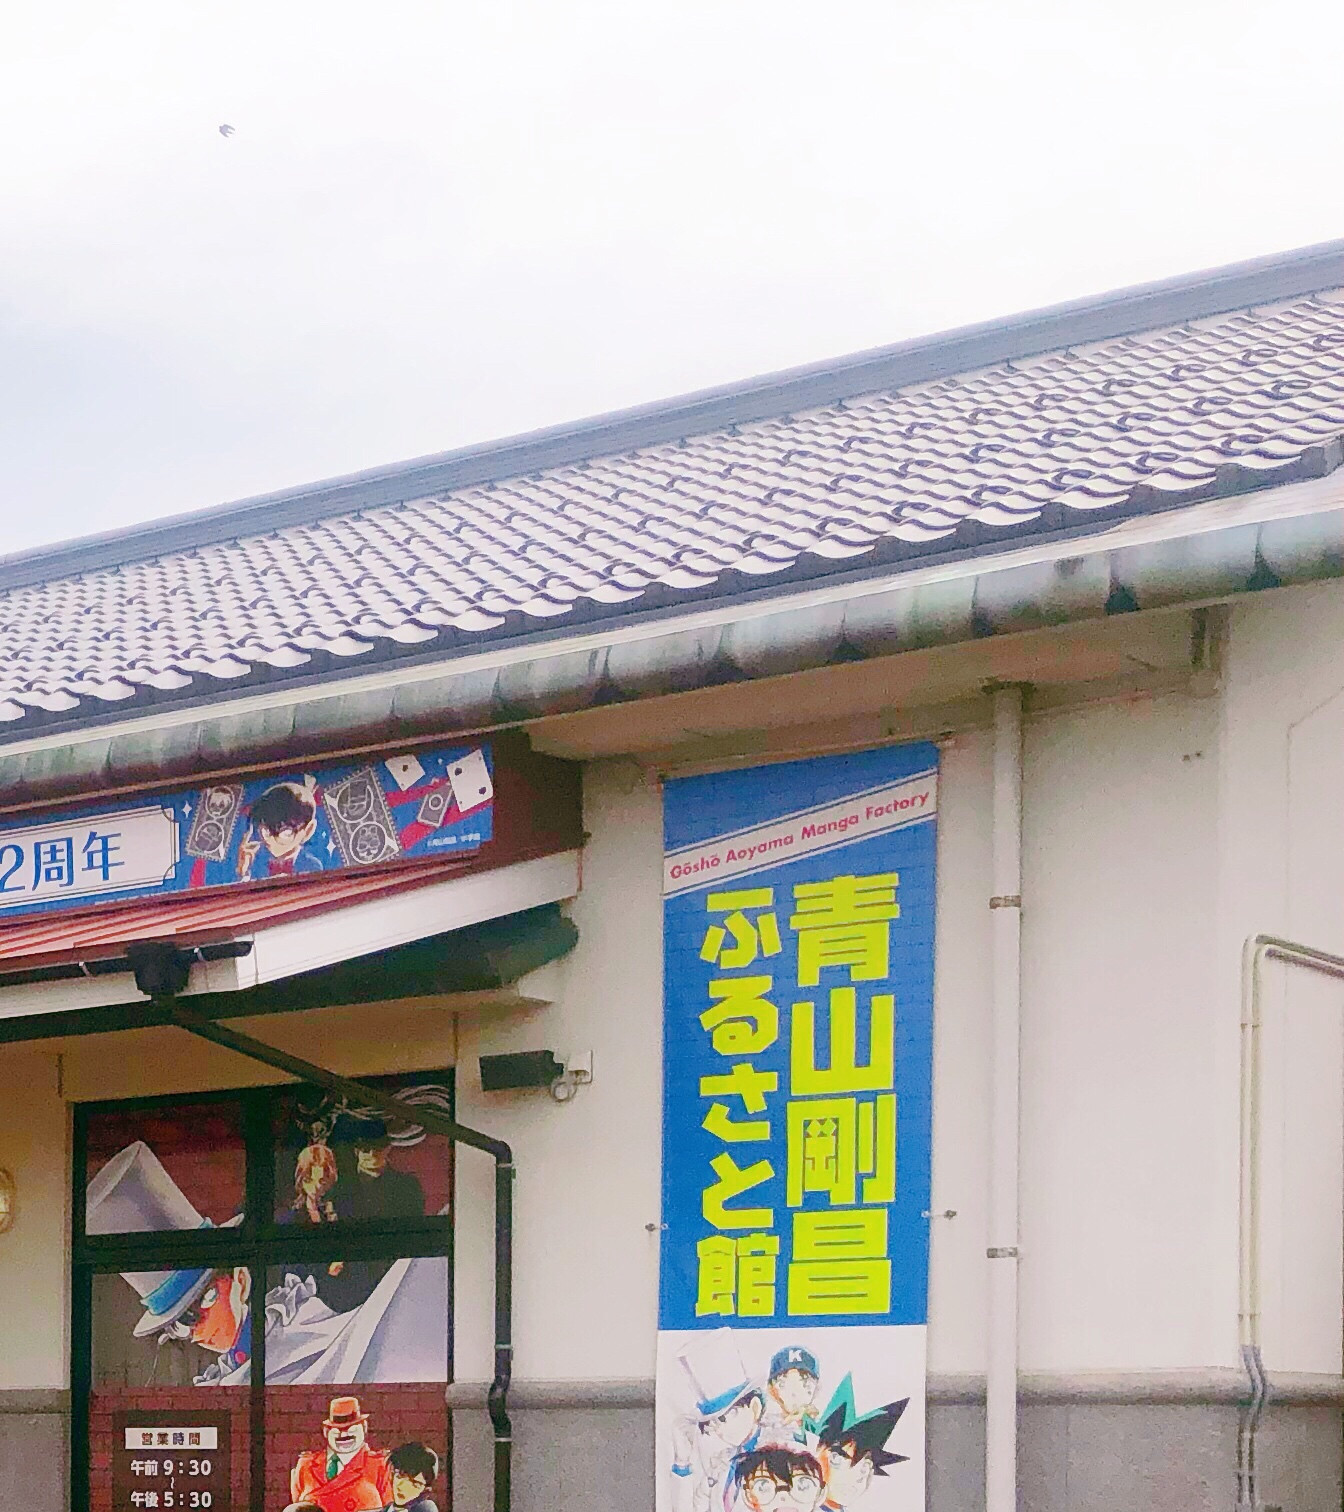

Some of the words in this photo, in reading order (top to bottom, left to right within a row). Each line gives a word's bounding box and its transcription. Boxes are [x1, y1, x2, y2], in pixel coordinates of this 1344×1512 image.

[725, 834, 795, 865] Aoyama
[800, 814, 860, 841] Manga
[865, 791, 931, 820] Factory
[694, 886, 783, 1318] ふるさと館
[785, 872, 901, 1318] 青山剛昌
[788, 1349, 803, 1363] K
[141, 1431, 201, 1446] 営業時間
[130, 1459, 159, 1476] 午前
[163, 1459, 212, 1476] 9:30
[130, 1490, 159, 1508] 午後
[163, 1491, 212, 1508] 5:30
